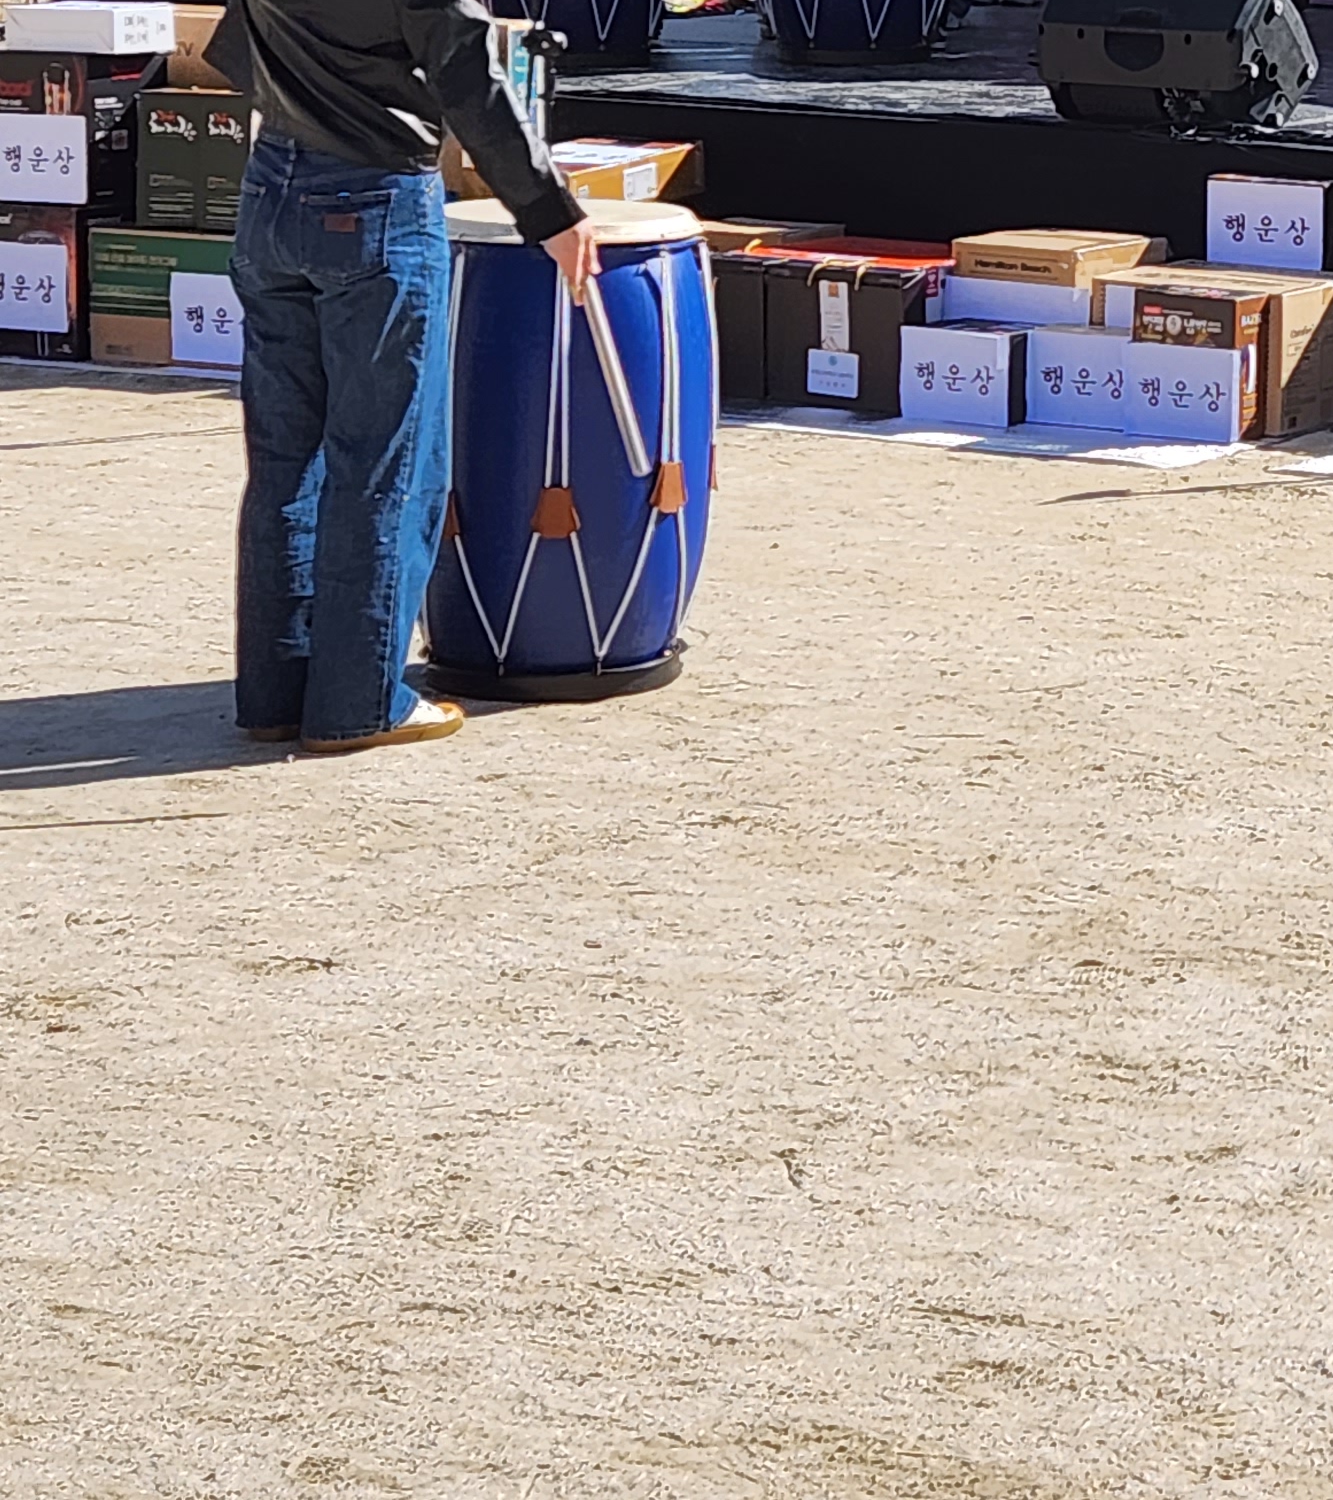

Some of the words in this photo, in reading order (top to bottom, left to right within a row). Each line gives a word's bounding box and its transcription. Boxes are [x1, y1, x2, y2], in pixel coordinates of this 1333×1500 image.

[4, 144, 76, 175] 행운상
[1222, 212, 1311, 247] 행운상
[184, 305, 242, 335] 행운
[913, 360, 996, 397] 행운상
[1040, 364, 1125, 401] 행운상
[1138, 376, 1227, 413] 행운상
